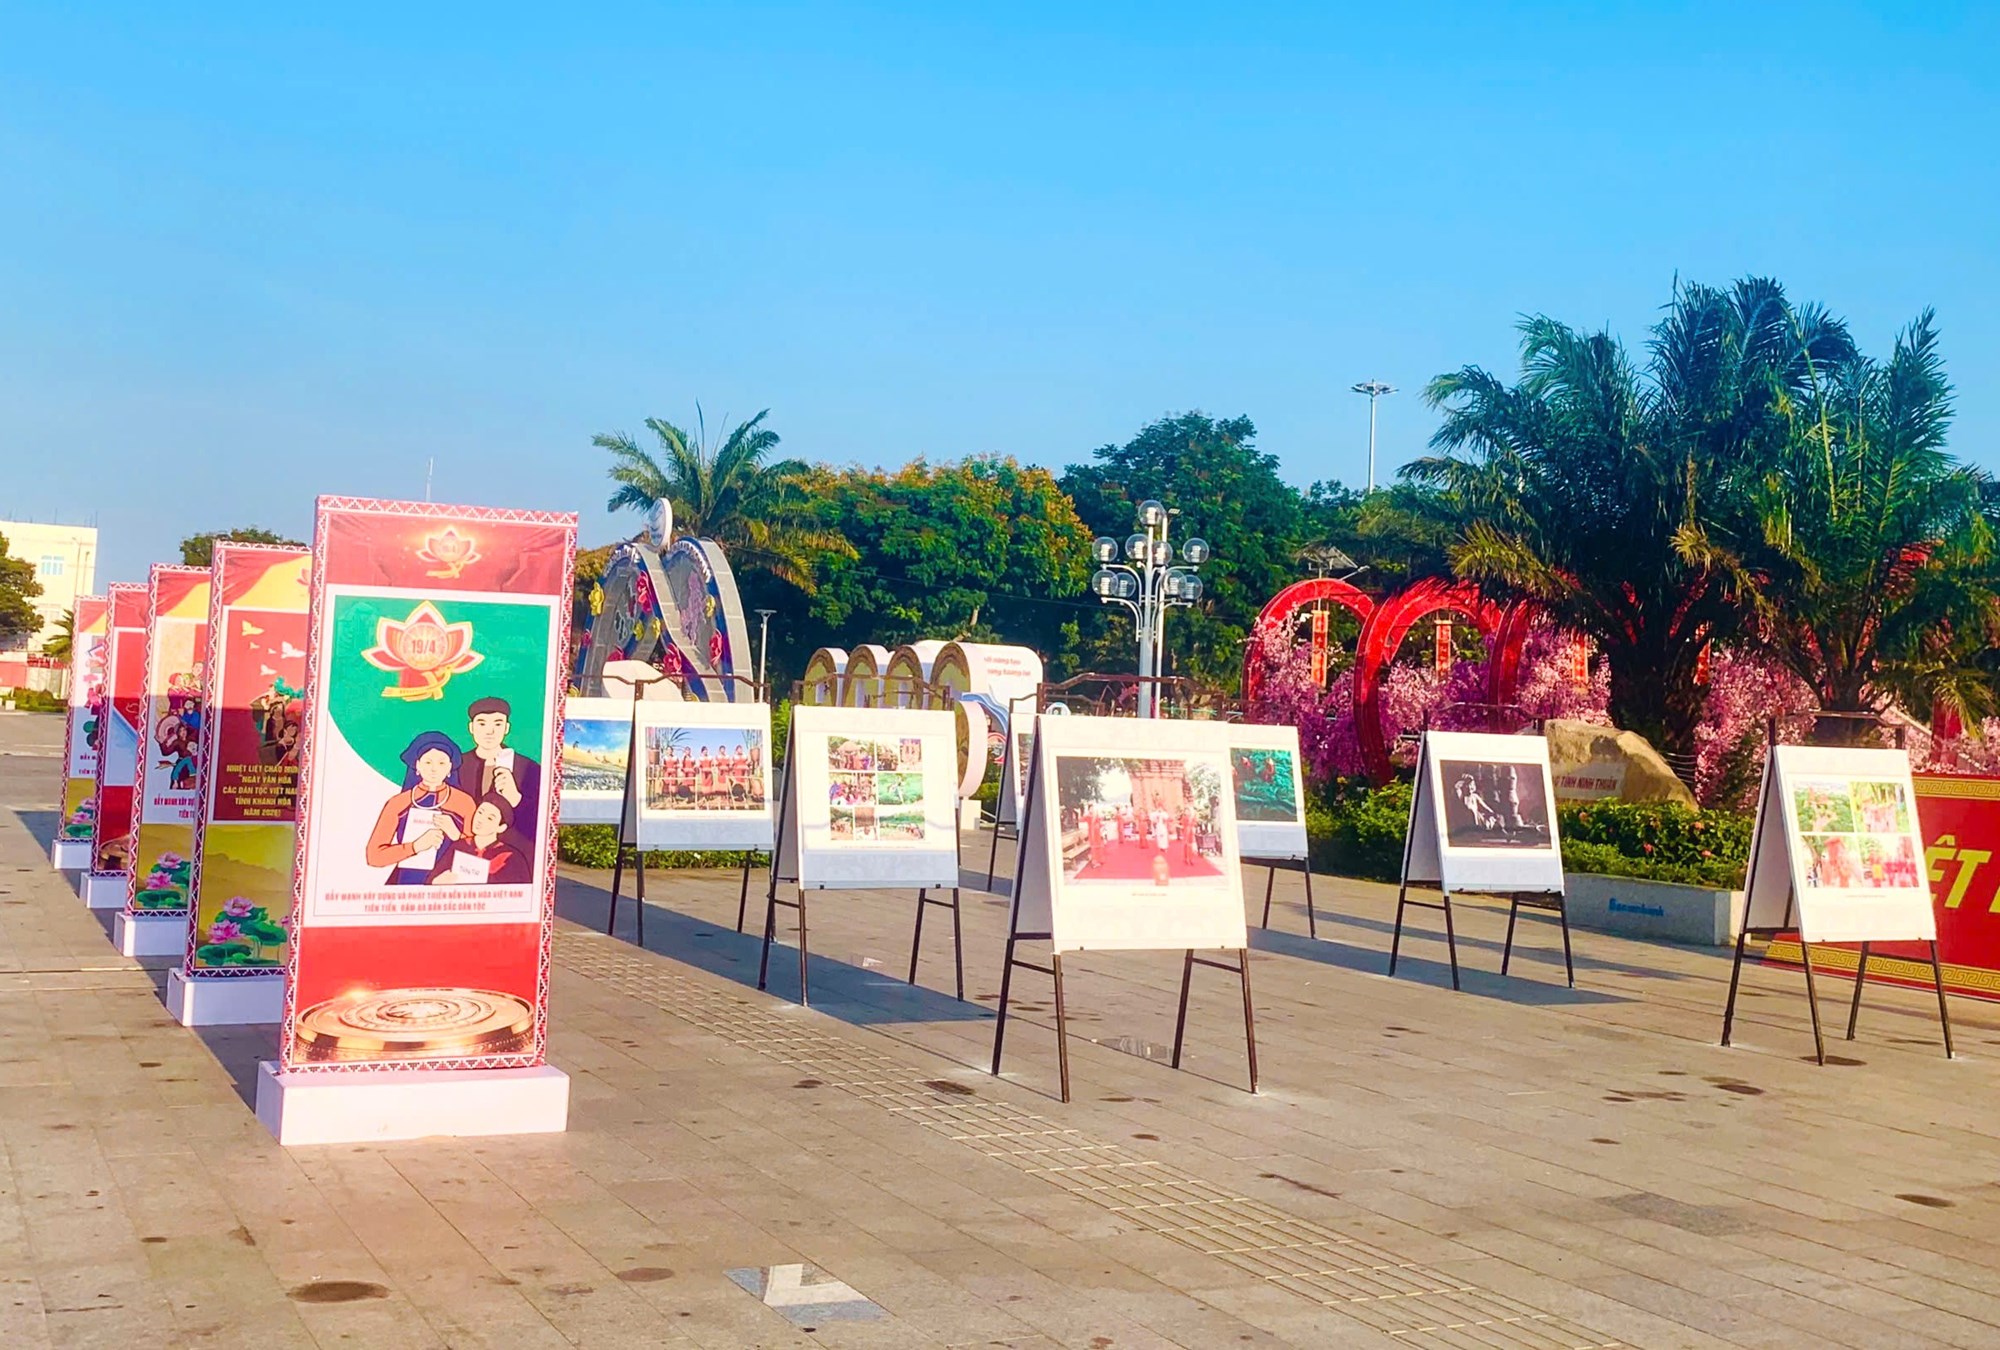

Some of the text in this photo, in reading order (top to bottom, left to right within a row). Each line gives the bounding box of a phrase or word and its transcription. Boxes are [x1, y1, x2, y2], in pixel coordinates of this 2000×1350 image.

[412, 640, 436, 654] 19/4
[222, 785, 237, 794] CÁC
[255, 786, 268, 796] TỘC
